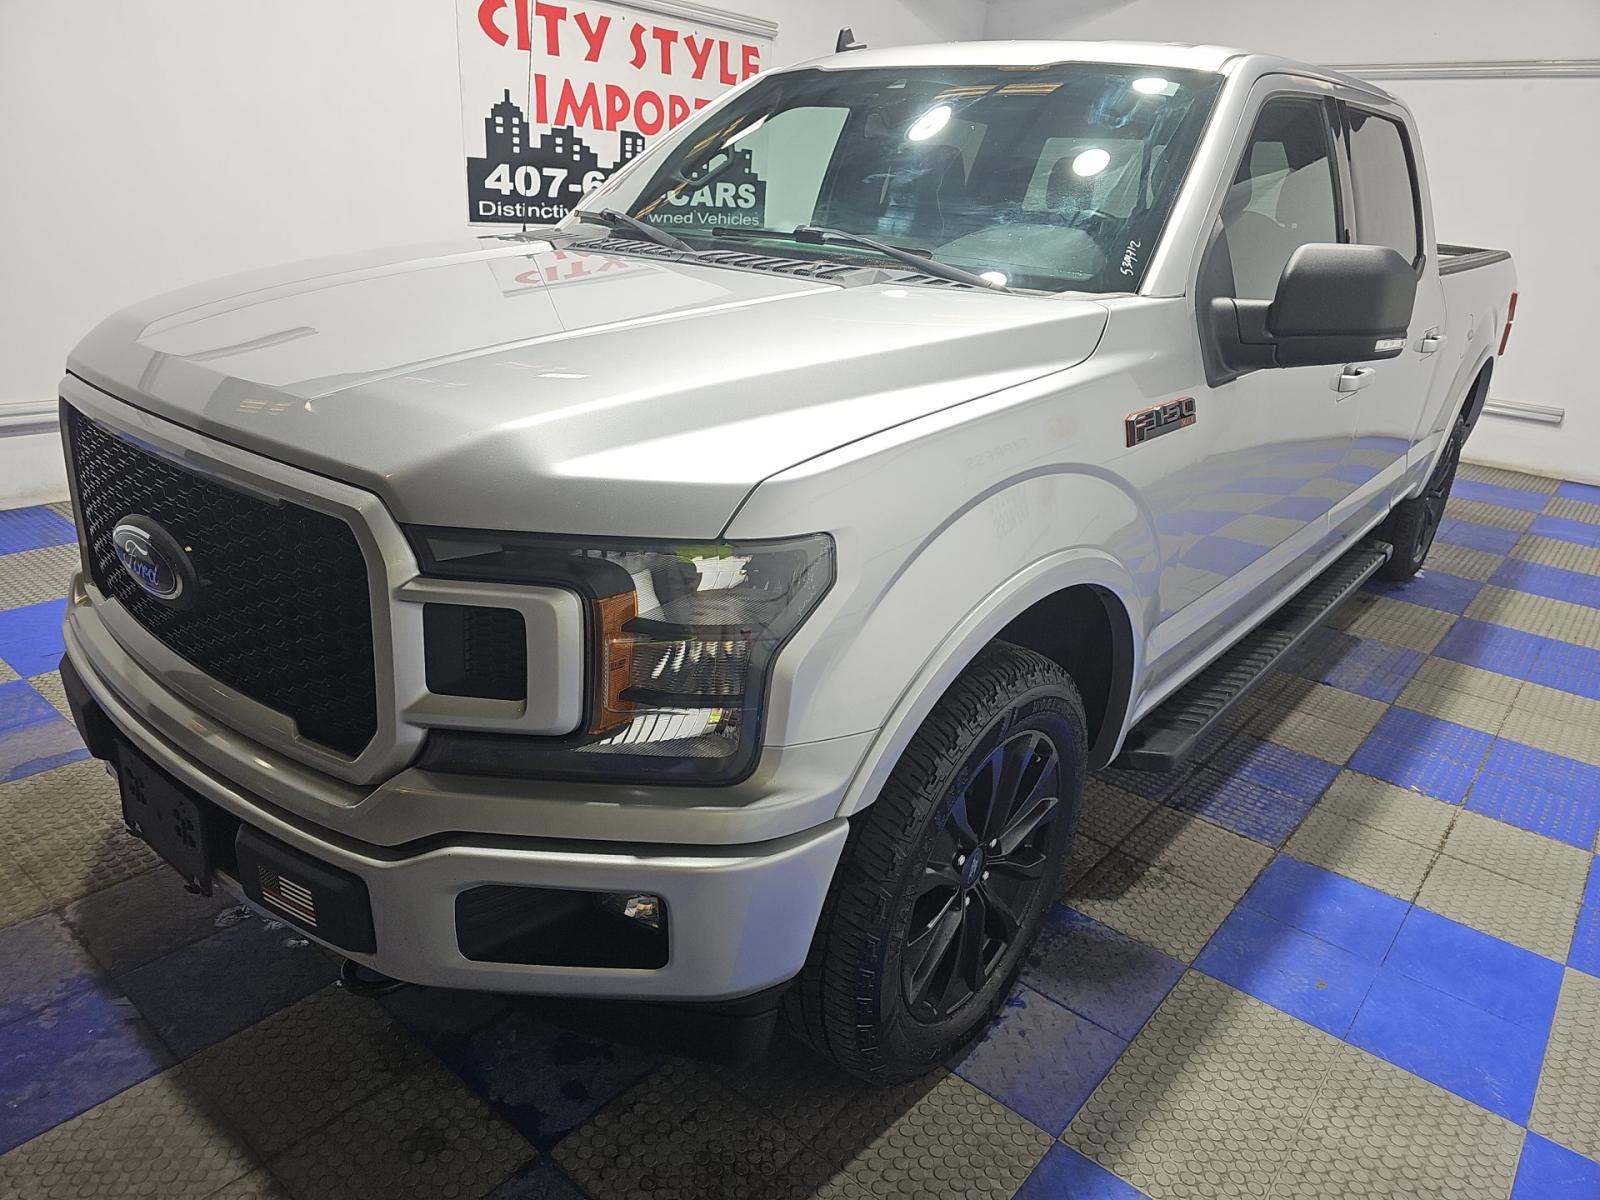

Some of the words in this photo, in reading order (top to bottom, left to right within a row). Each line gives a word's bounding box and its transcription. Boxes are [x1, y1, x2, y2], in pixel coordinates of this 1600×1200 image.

[477, 0, 613, 63] CITY
[628, 22, 761, 87] STYLE
[484, 163, 617, 198] 407-6
[648, 212, 694, 225] wned
[697, 212, 760, 226] Vehicles
[123, 539, 160, 586] Ford
